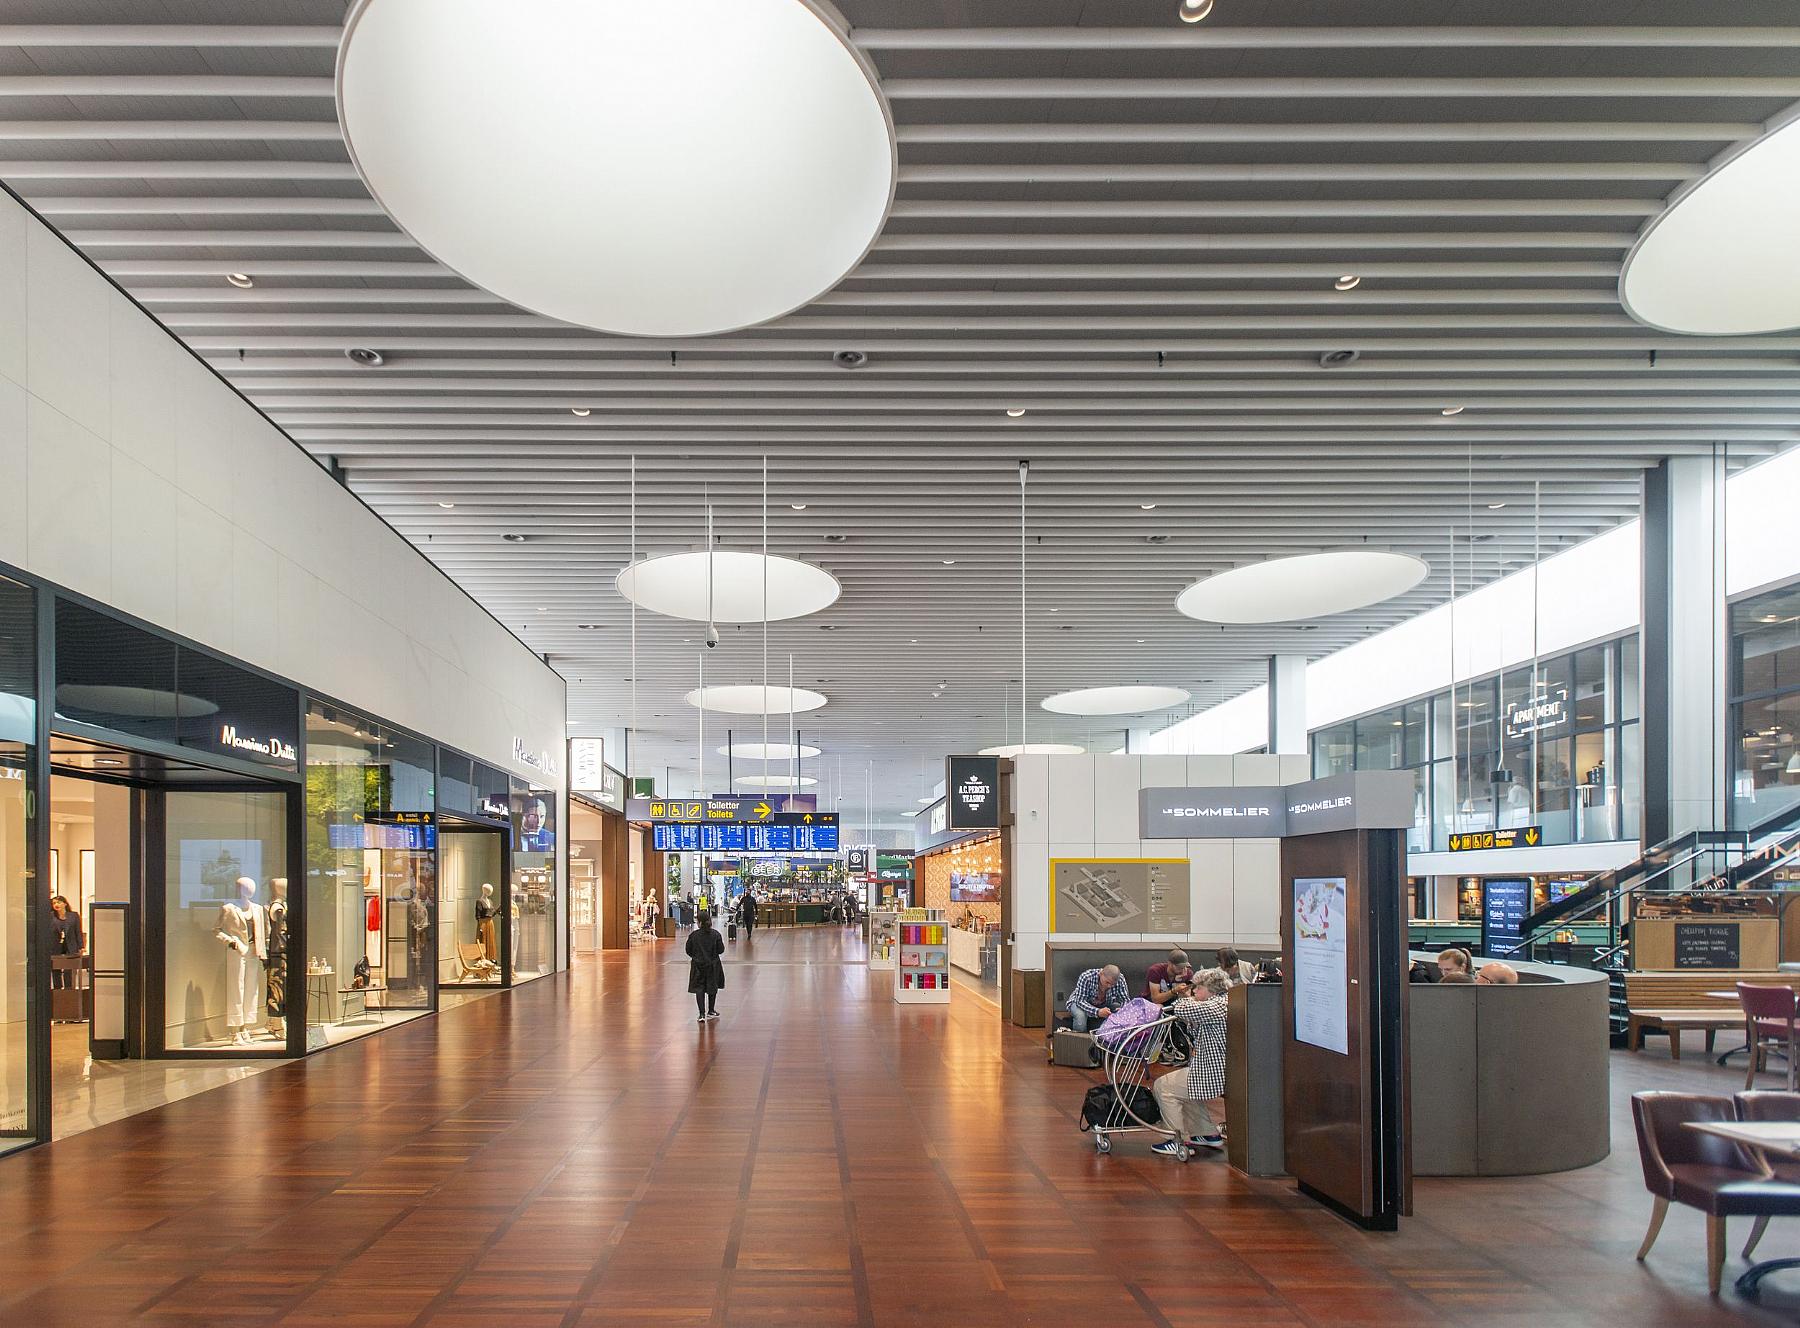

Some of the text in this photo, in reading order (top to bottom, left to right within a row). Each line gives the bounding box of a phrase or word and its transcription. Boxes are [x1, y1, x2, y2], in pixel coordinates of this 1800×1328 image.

[222, 725, 296, 760] Massimo Dutti
[962, 795, 986, 803] TEASHOP
[707, 801, 740, 810] Toiletter
[1294, 796, 1352, 814] SOMMELIER
[707, 810, 734, 819] Toilets
[1173, 807, 1270, 817] SOMMELIER
[1495, 831, 1518, 839] Toiletter
[836, 844, 876, 855] ARKET
